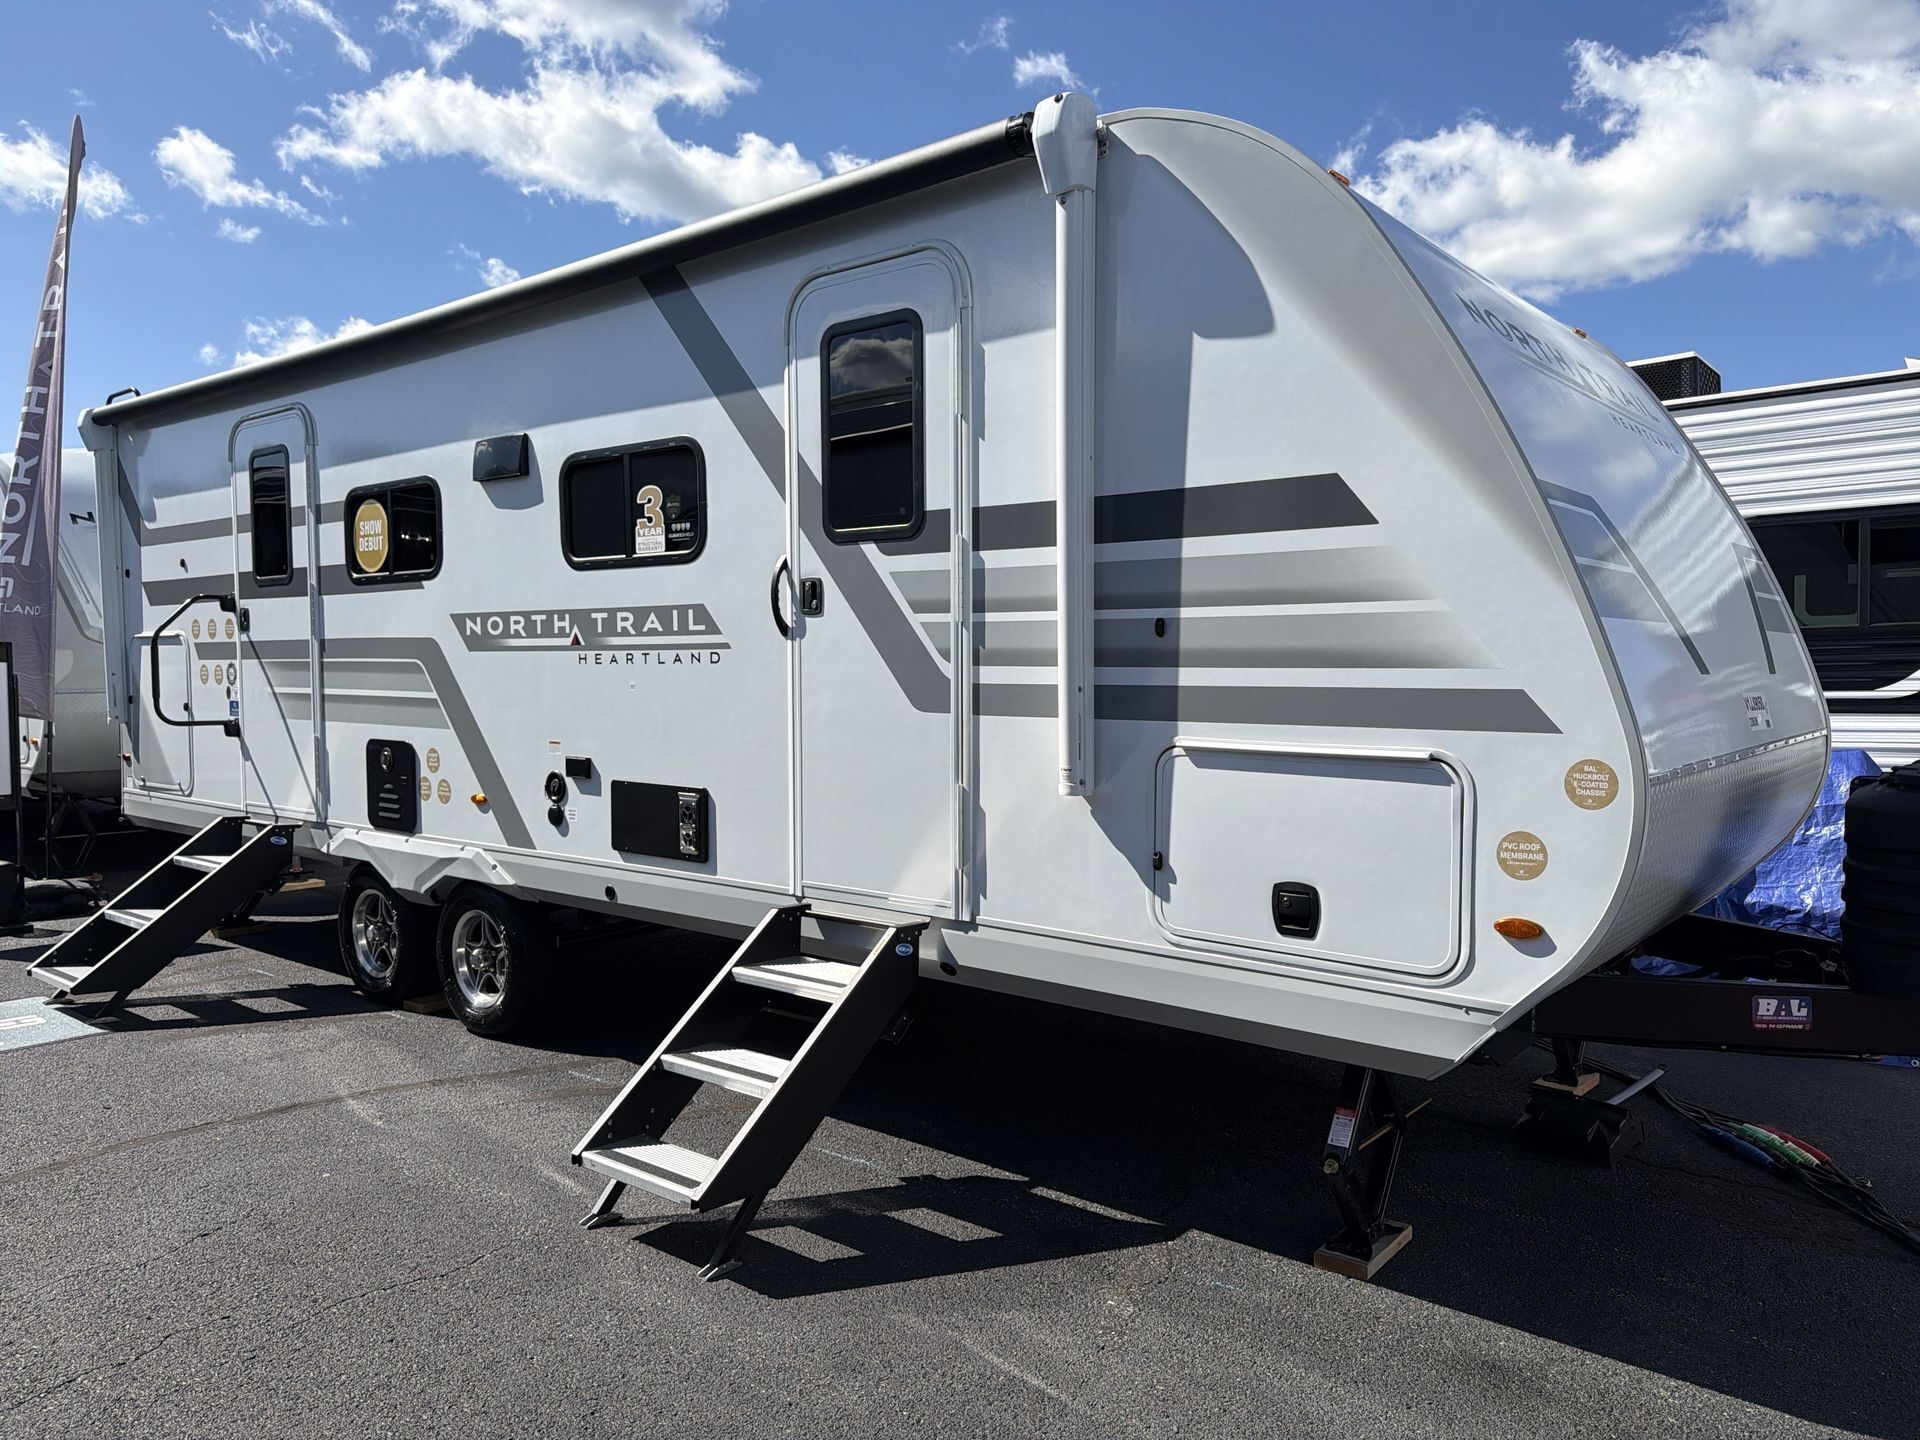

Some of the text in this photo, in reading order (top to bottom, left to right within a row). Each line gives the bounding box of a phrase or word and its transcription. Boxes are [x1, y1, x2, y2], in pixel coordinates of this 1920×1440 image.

[1453, 289, 1660, 423] NORTH TRAIL
[637, 485, 664, 528] 3
[359, 519, 383, 536] SHOW
[638, 527, 663, 537] YEAR
[359, 536, 384, 552] DEBUT
[465, 608, 707, 637] NORTH TRAIL
[578, 651, 722, 665] HEARTLAND
[1573, 772, 1610, 781] HUCKBOLT
[1573, 780, 1609, 789] E-COATED
[1575, 788, 1606, 797] CHASSIS
[1502, 842, 1541, 851] PVC ROOF
[1500, 851, 1545, 861] MEMBRANE
[1757, 998, 1808, 1017] BAL
